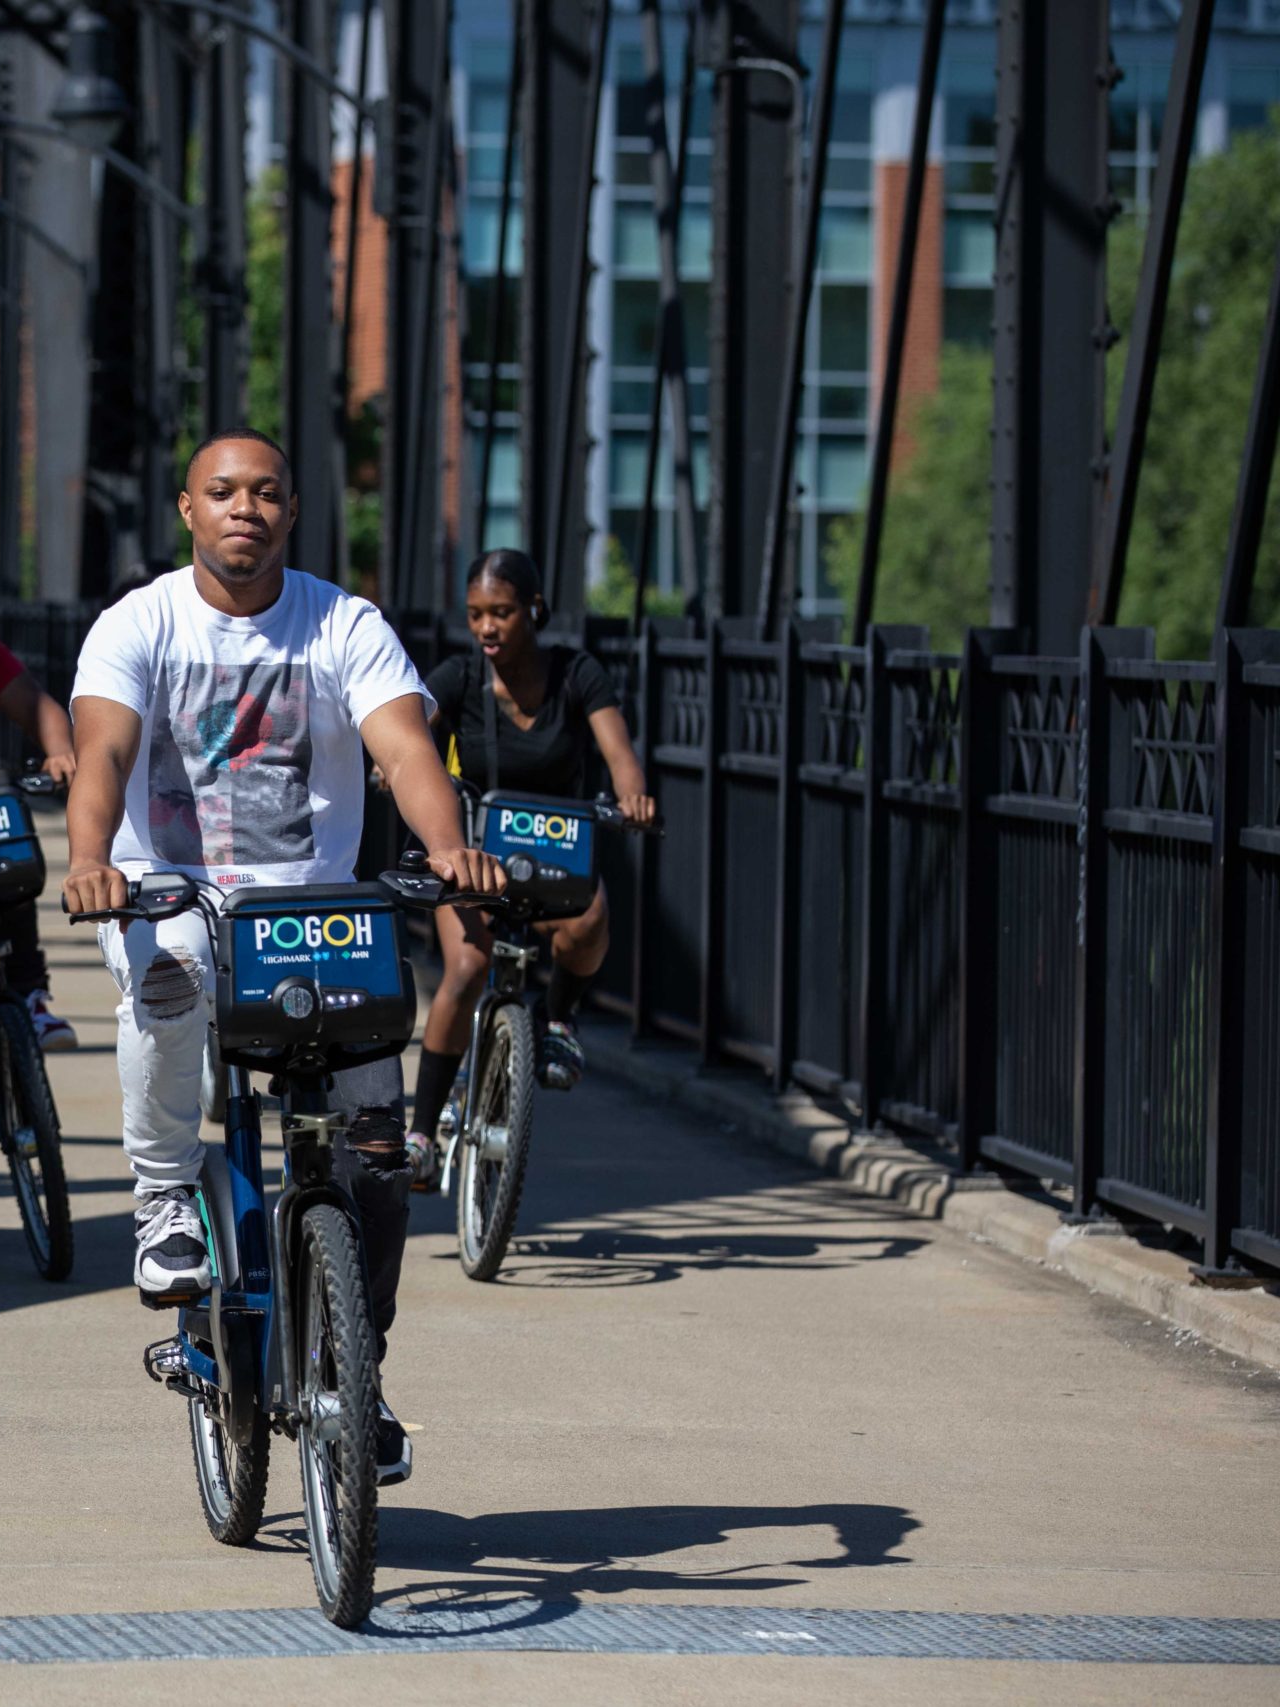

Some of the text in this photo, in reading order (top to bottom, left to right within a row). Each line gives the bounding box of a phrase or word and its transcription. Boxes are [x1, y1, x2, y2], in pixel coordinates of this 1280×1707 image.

[500, 809, 579, 842] POGOH
[217, 874, 255, 885] HEARTLESS
[254, 914, 373, 950] POGOH
[263, 951, 369, 964] HIGHMARK AHN
